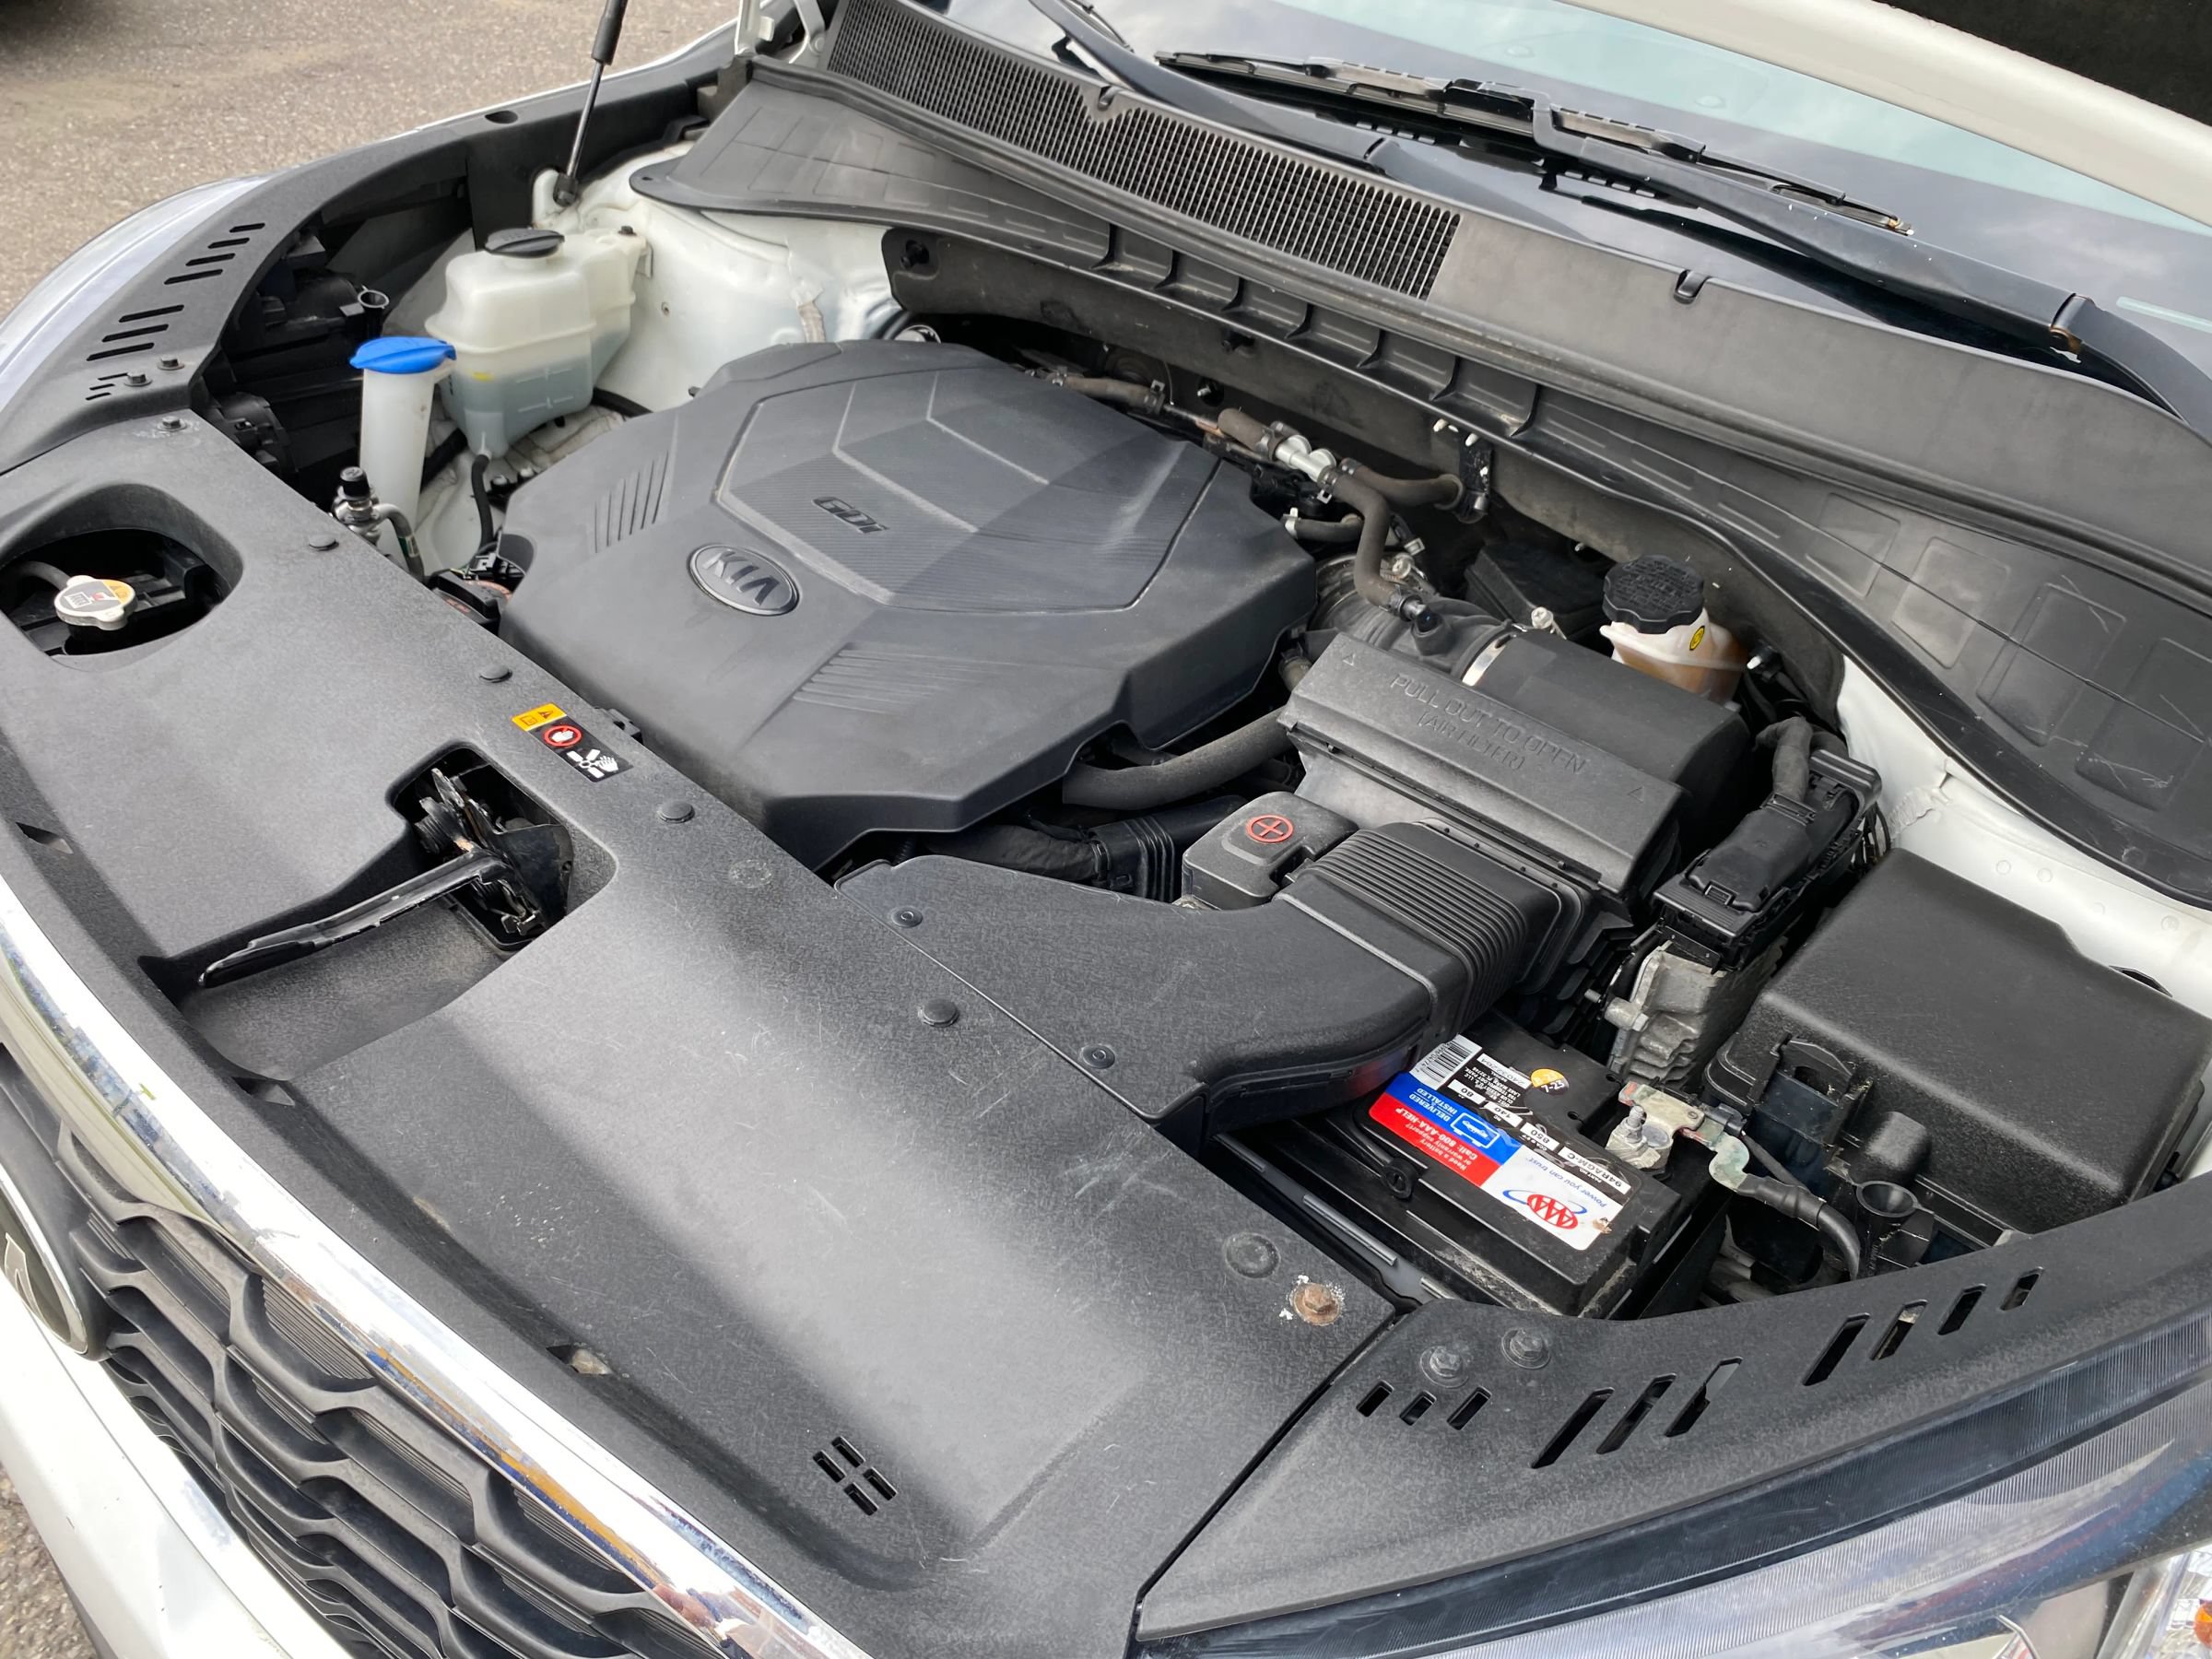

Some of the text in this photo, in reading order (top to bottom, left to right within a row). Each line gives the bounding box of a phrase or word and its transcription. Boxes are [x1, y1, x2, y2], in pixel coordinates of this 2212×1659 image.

[701, 547, 781, 606] KIA
[1390, 674, 1586, 774] PULL OUT TO OPEN
[1460, 1088, 1475, 1098] 80
[1541, 1080, 1565, 1093] 7-23
[1408, 1093, 1451, 1122] DELIVERED
[1417, 1088, 1458, 1114] INSTALLED
[1494, 1106, 1512, 1118] 140
[1394, 1106, 1478, 1161] Call: 800-AAA-HELP
[1404, 1122, 1436, 1143] support?
[1530, 1129, 1550, 1144] 850
[1418, 1138, 1444, 1156] battery
[1432, 1140, 1464, 1160] warranty
[1447, 1157, 1468, 1171] Need
[1566, 1151, 1622, 1187] 94RAGM-C
[1548, 1170, 1564, 1181] can
[1563, 1179, 1581, 1191] you
[1581, 1189, 1607, 1208] Power
[1530, 1194, 1577, 1229] AAA
